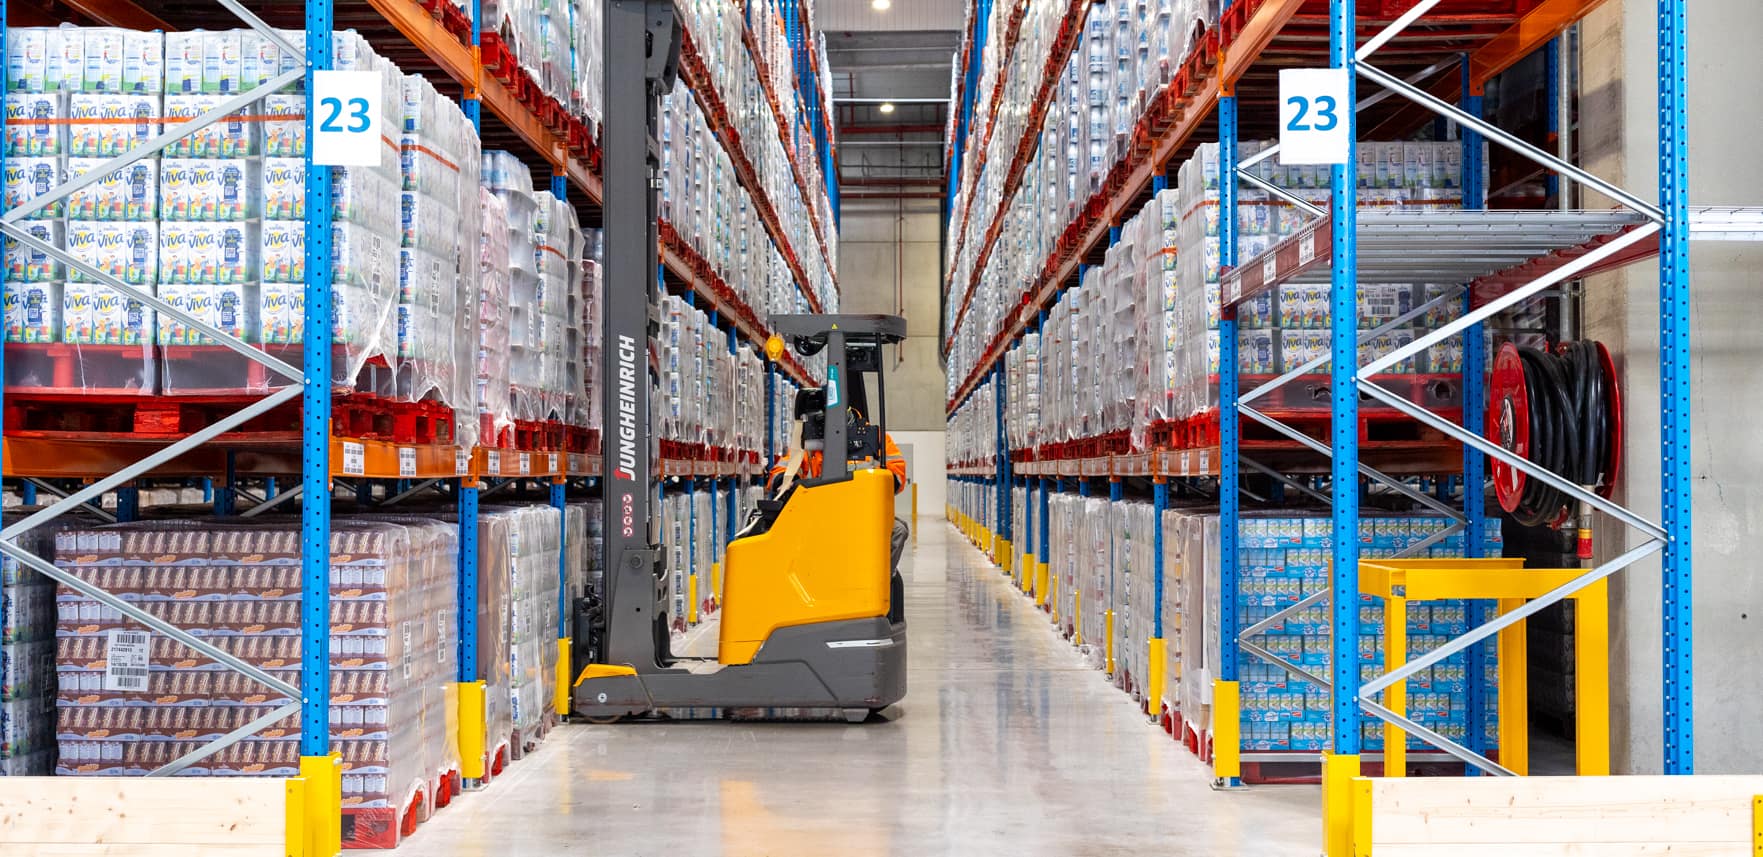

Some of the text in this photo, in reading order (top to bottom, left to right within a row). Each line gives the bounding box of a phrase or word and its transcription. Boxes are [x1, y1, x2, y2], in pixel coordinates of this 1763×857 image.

[320, 97, 371, 133] 23
[1287, 95, 1338, 131] 23
[614, 335, 636, 481] JUNGHEINRICH
